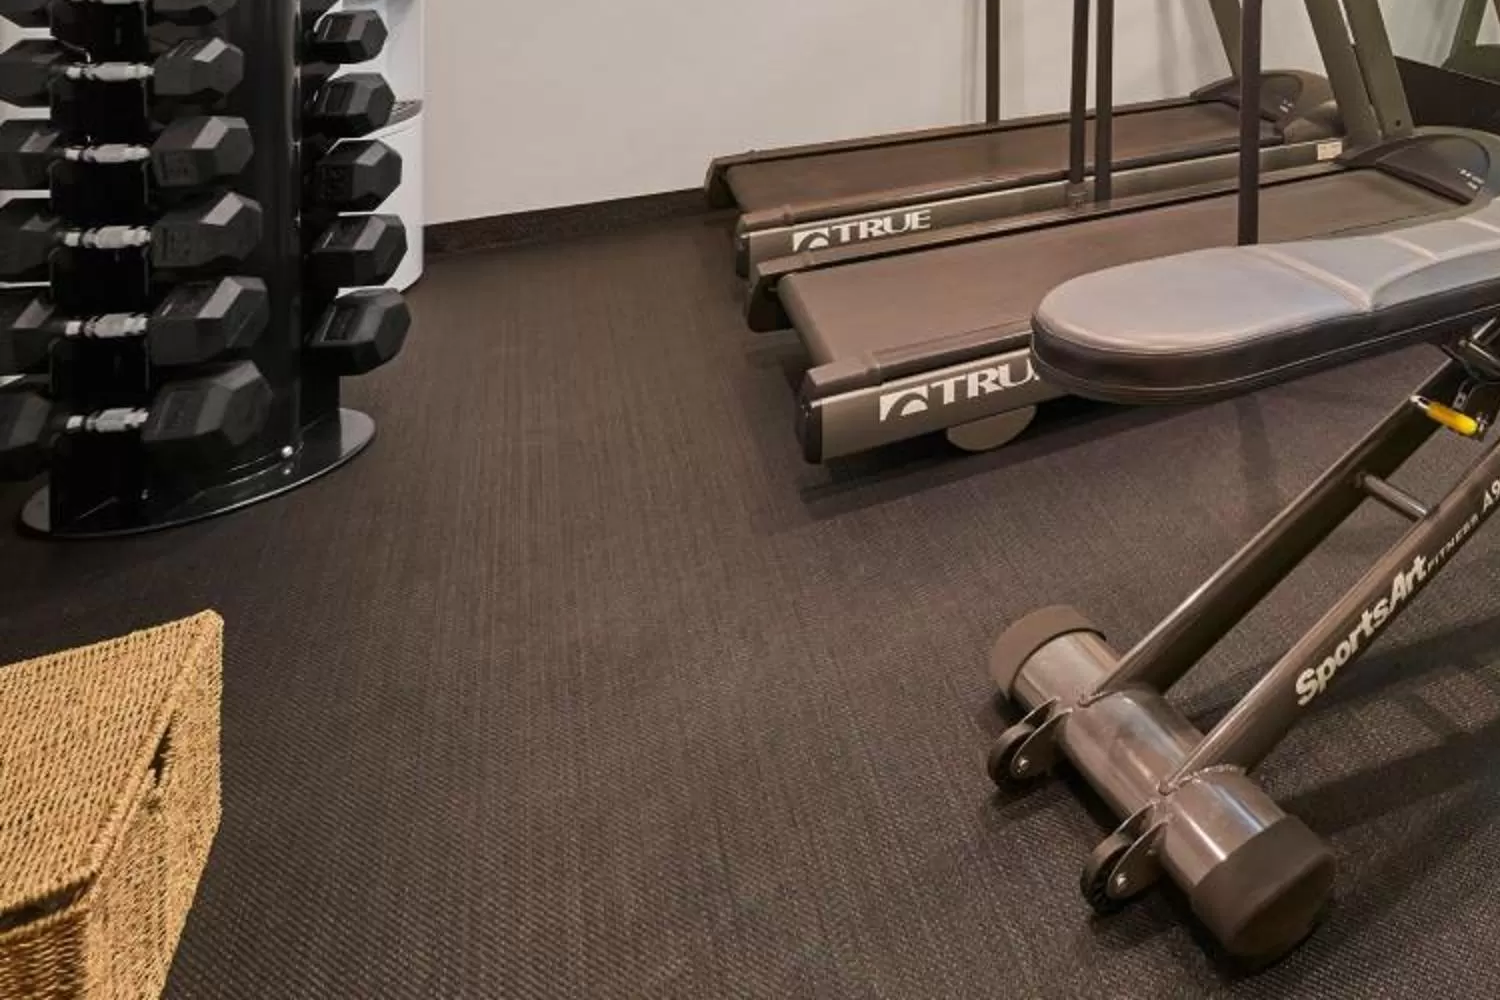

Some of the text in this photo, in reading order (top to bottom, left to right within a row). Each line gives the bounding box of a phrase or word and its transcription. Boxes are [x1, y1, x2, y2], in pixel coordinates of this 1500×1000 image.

[831, 209, 931, 242] TRUE
[931, 360, 1040, 404] TRU
[1295, 554, 1427, 705] SportsArt
